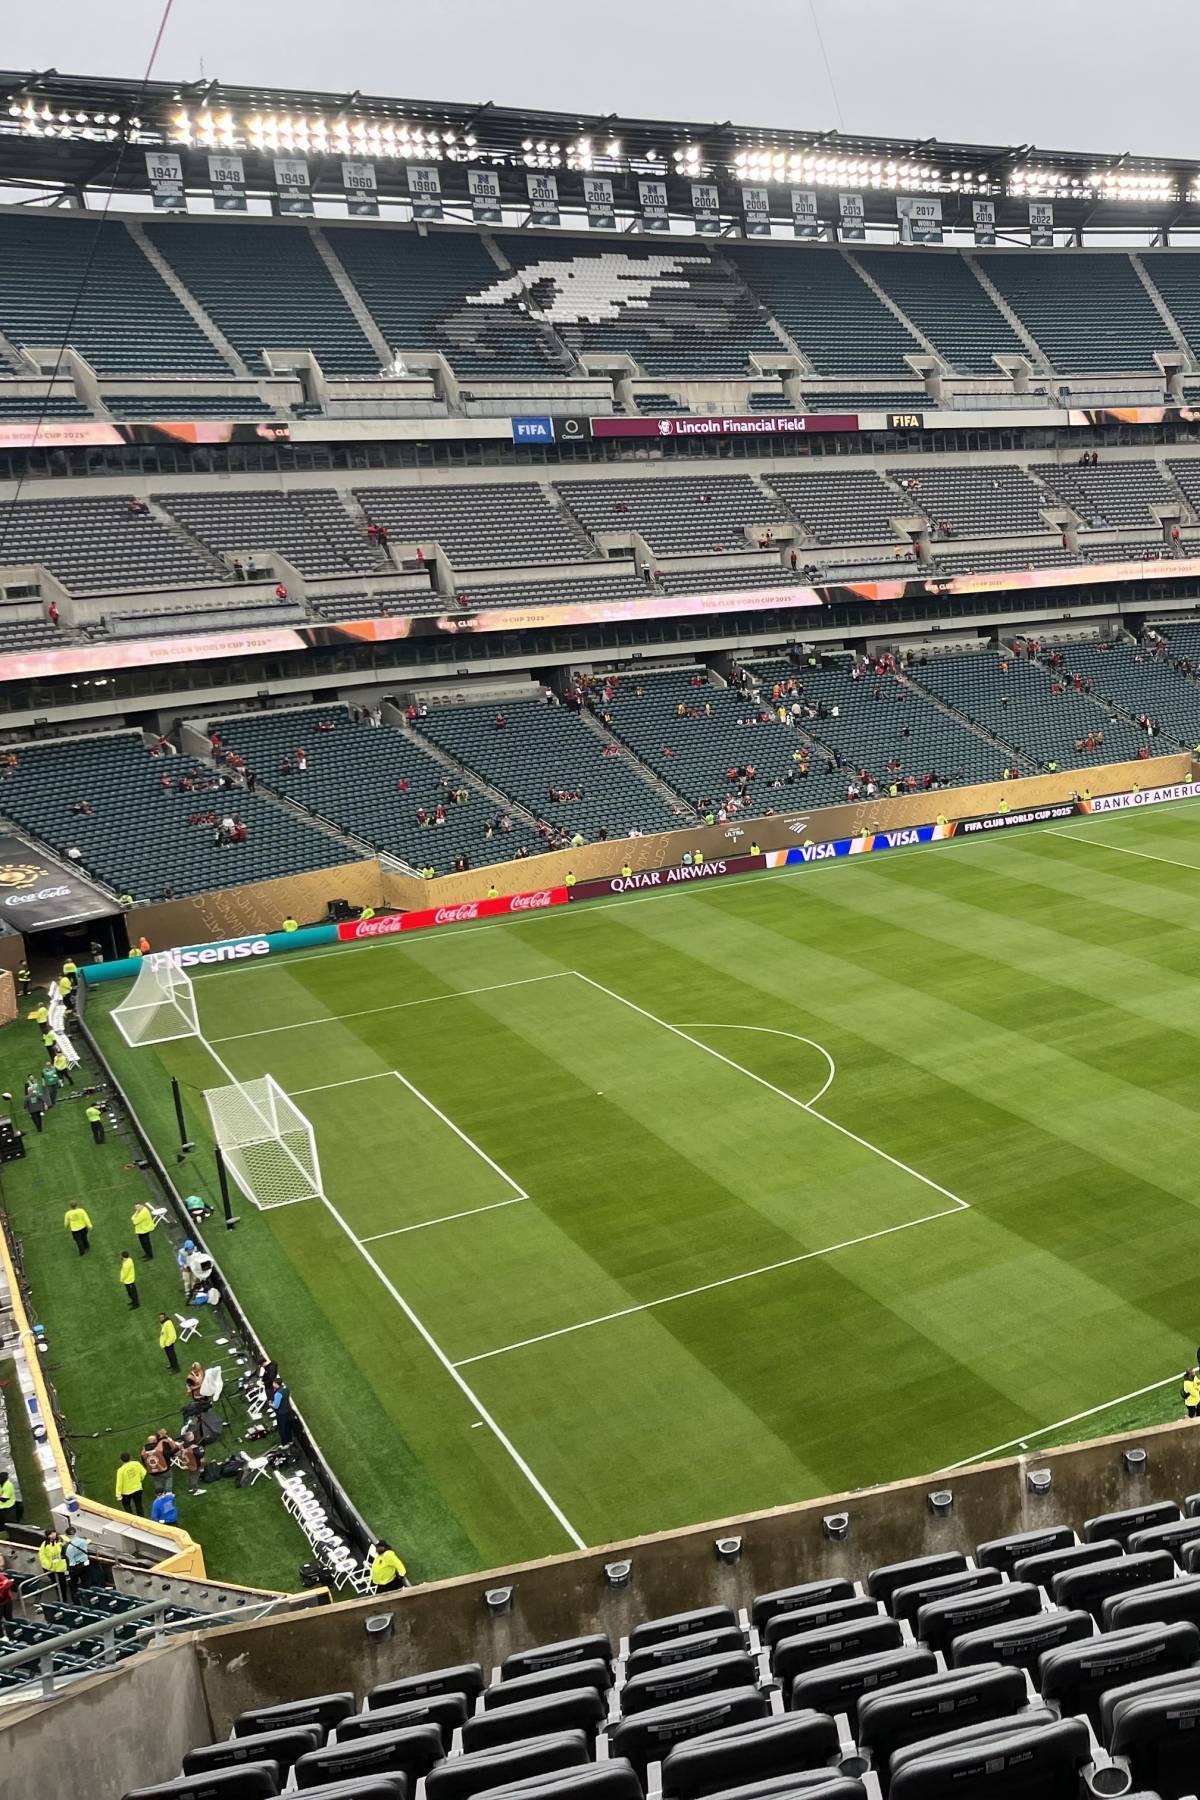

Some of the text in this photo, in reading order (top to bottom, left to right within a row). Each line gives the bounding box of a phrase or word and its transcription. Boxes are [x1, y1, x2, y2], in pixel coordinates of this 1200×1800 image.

[152, 167, 178, 179] 1947
[214, 169, 241, 182] 1948
[280, 173, 306, 184] 1949
[348, 176, 372, 188] 1960
[412, 180, 437, 192] 1980
[473, 183, 496, 195] 1988
[532, 188, 555, 199] 2001
[588, 192, 612, 202] 2002
[642, 194, 665, 205] 2003
[694, 197, 716, 207] 2004
[745, 200, 767, 210] 2006
[795, 203, 814, 213] 2010
[843, 205, 861, 215] 2013
[916, 206, 935, 216] 2017
[976, 212, 992, 222] 2019
[1031, 215, 1051, 224] 2022
[676, 418, 806, 434] Lincoln Financial Field
[892, 415, 919, 427] FIFA
[518, 424, 546, 436] FIFA
[1094, 794, 1130, 811] BANK
[1134, 792, 1150, 804] OF
[964, 821, 983, 831] FIFA
[983, 818, 1004, 829] CLUB
[1005, 813, 1034, 826] WORLD
[1034, 810, 1052, 821] CUP
[884, 829, 920, 848] VISA
[798, 843, 836, 862] VISA
[610, 861, 728, 893] QATAR AIRWAYS
[4, 885, 71, 906] Coca-Cola
